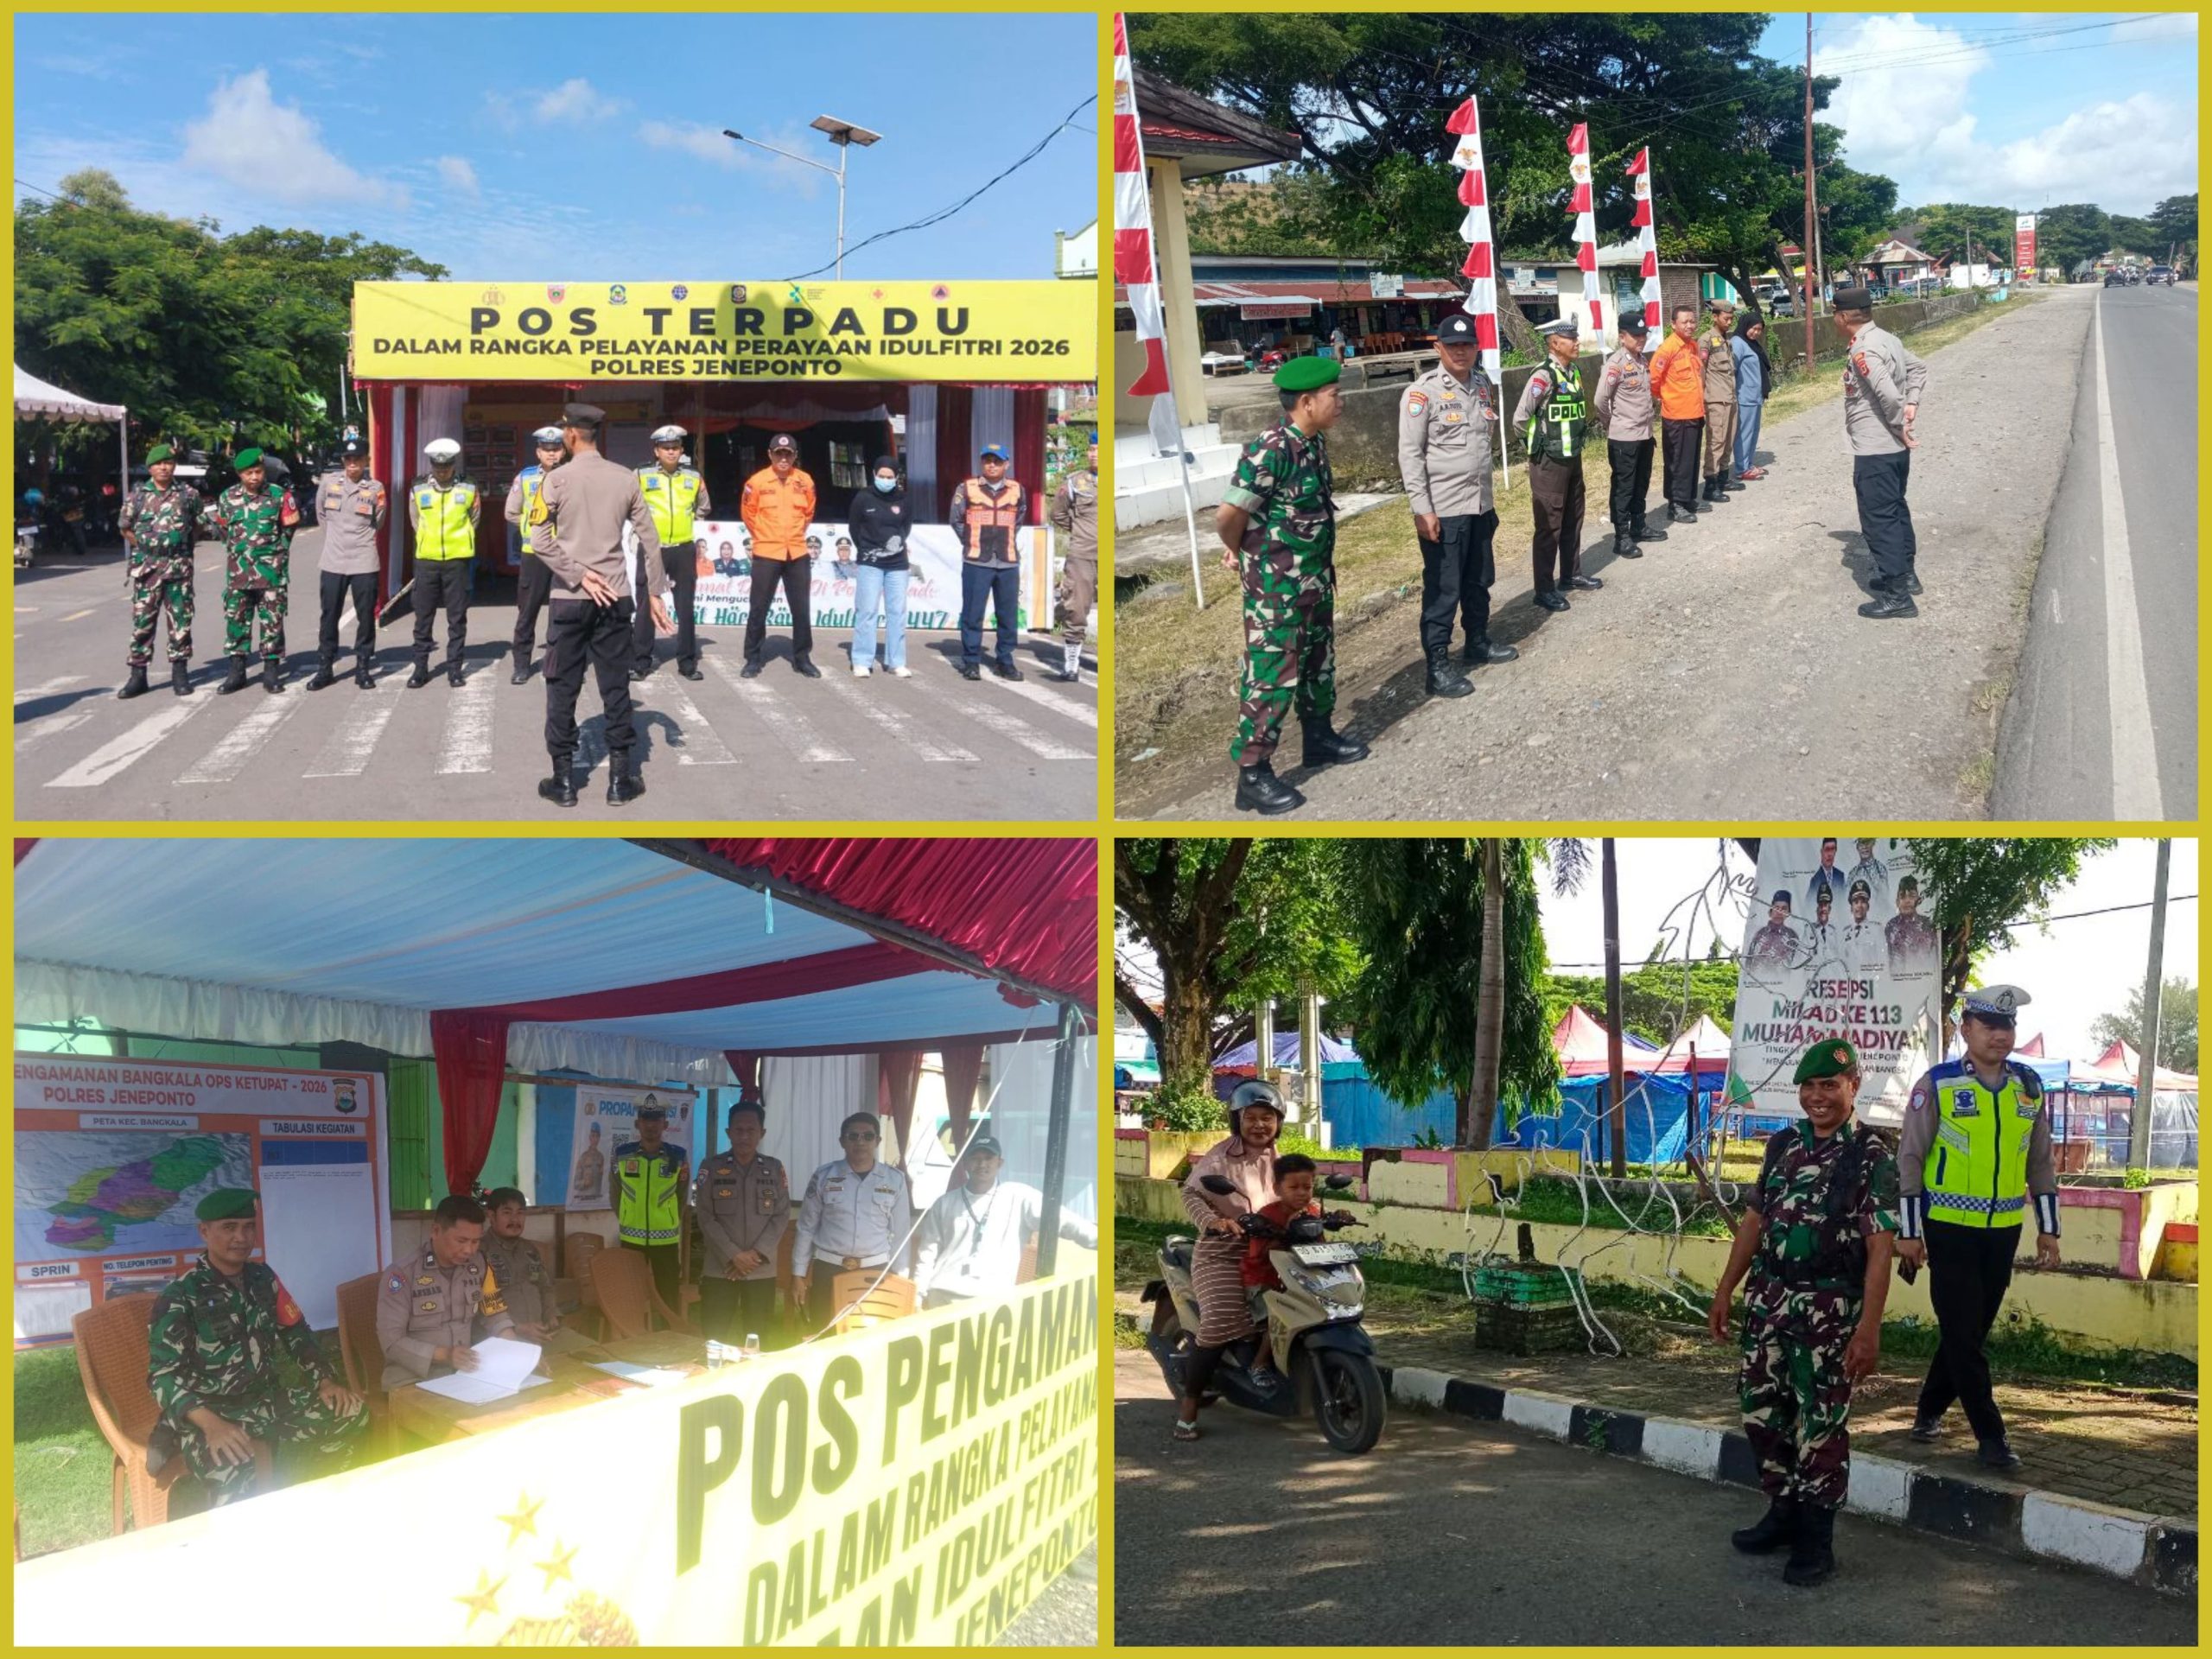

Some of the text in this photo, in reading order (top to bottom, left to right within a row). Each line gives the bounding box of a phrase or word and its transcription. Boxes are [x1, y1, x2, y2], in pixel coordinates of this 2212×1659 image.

[471, 307, 969, 335] POS TERPADU
[373, 339, 1071, 356] DALAM RANGKA PELAYANAN PERAYAAN IDULFITRI 2026
[591, 359, 842, 376] POLRES JENEPONTO
[1807, 979, 1874, 1000] RESEPSI
[1871, 1005, 1902, 1025] 113
[123, 1069, 202, 1088] BANGKALA
[206, 1074, 232, 1089] OPS
[236, 1076, 289, 1092] KETUPAT
[301, 1080, 327, 1094] 2026
[44, 1087, 195, 1107] POLRES JENEPONTO
[600, 1100, 636, 1117] PROPA
[93, 1117, 116, 1126] PETA
[141, 1118, 188, 1127] BANGKALA
[272, 1122, 355, 1135] TABULASI KEGIATAN
[31, 1264, 71, 1277] SPRIN
[117, 1260, 145, 1270] TELEPON
[146, 1257, 173, 1267] PENTING
[677, 1354, 863, 1578] POS
[743, 1487, 899, 1647] DALAM
[902, 1419, 1010, 1554] RANGKA
[933, 1494, 1014, 1619] IDUL
[1019, 1437, 1088, 1545] FITRI
